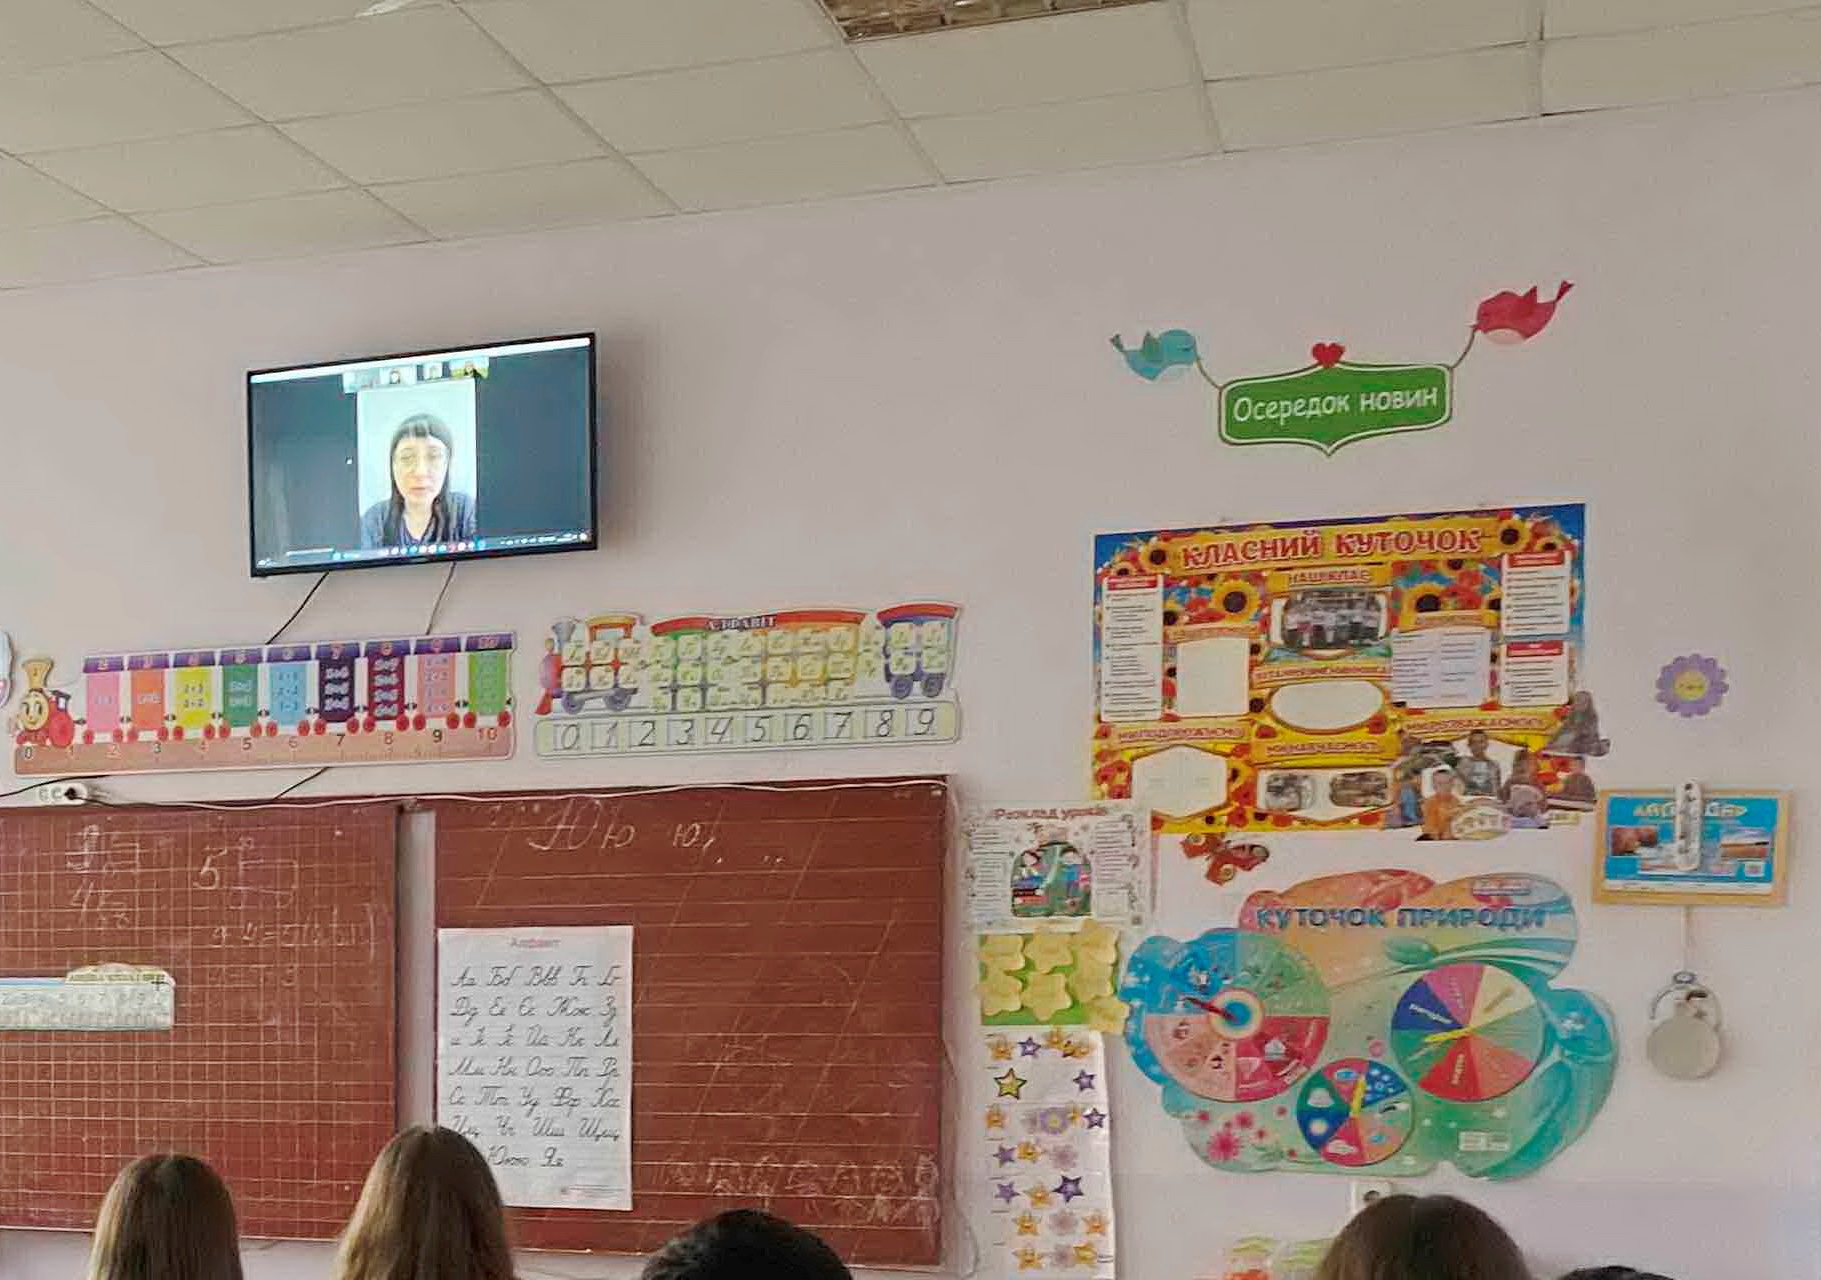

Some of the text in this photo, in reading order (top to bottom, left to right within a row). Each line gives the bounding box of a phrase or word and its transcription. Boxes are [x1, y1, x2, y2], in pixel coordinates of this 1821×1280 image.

[1233, 387, 1438, 426] Осередок новин
[1182, 529, 1481, 568] КЛАСНИЙ КУТОЧОК
[153, 741, 162, 753] 3
[242, 737, 252, 750] 5
[337, 733, 346, 746] 7
[384, 731, 394, 744] 8
[433, 729, 443, 743] 9
[478, 728, 498, 741] 10
[561, 708, 935, 750] 0 1 2 3 4 5 6 7 8 9
[1257, 907, 1549, 931] КУТОЧОК ПРИРОДИ
[451, 966, 477, 986] Аа
[486, 965, 523, 986] Бб
